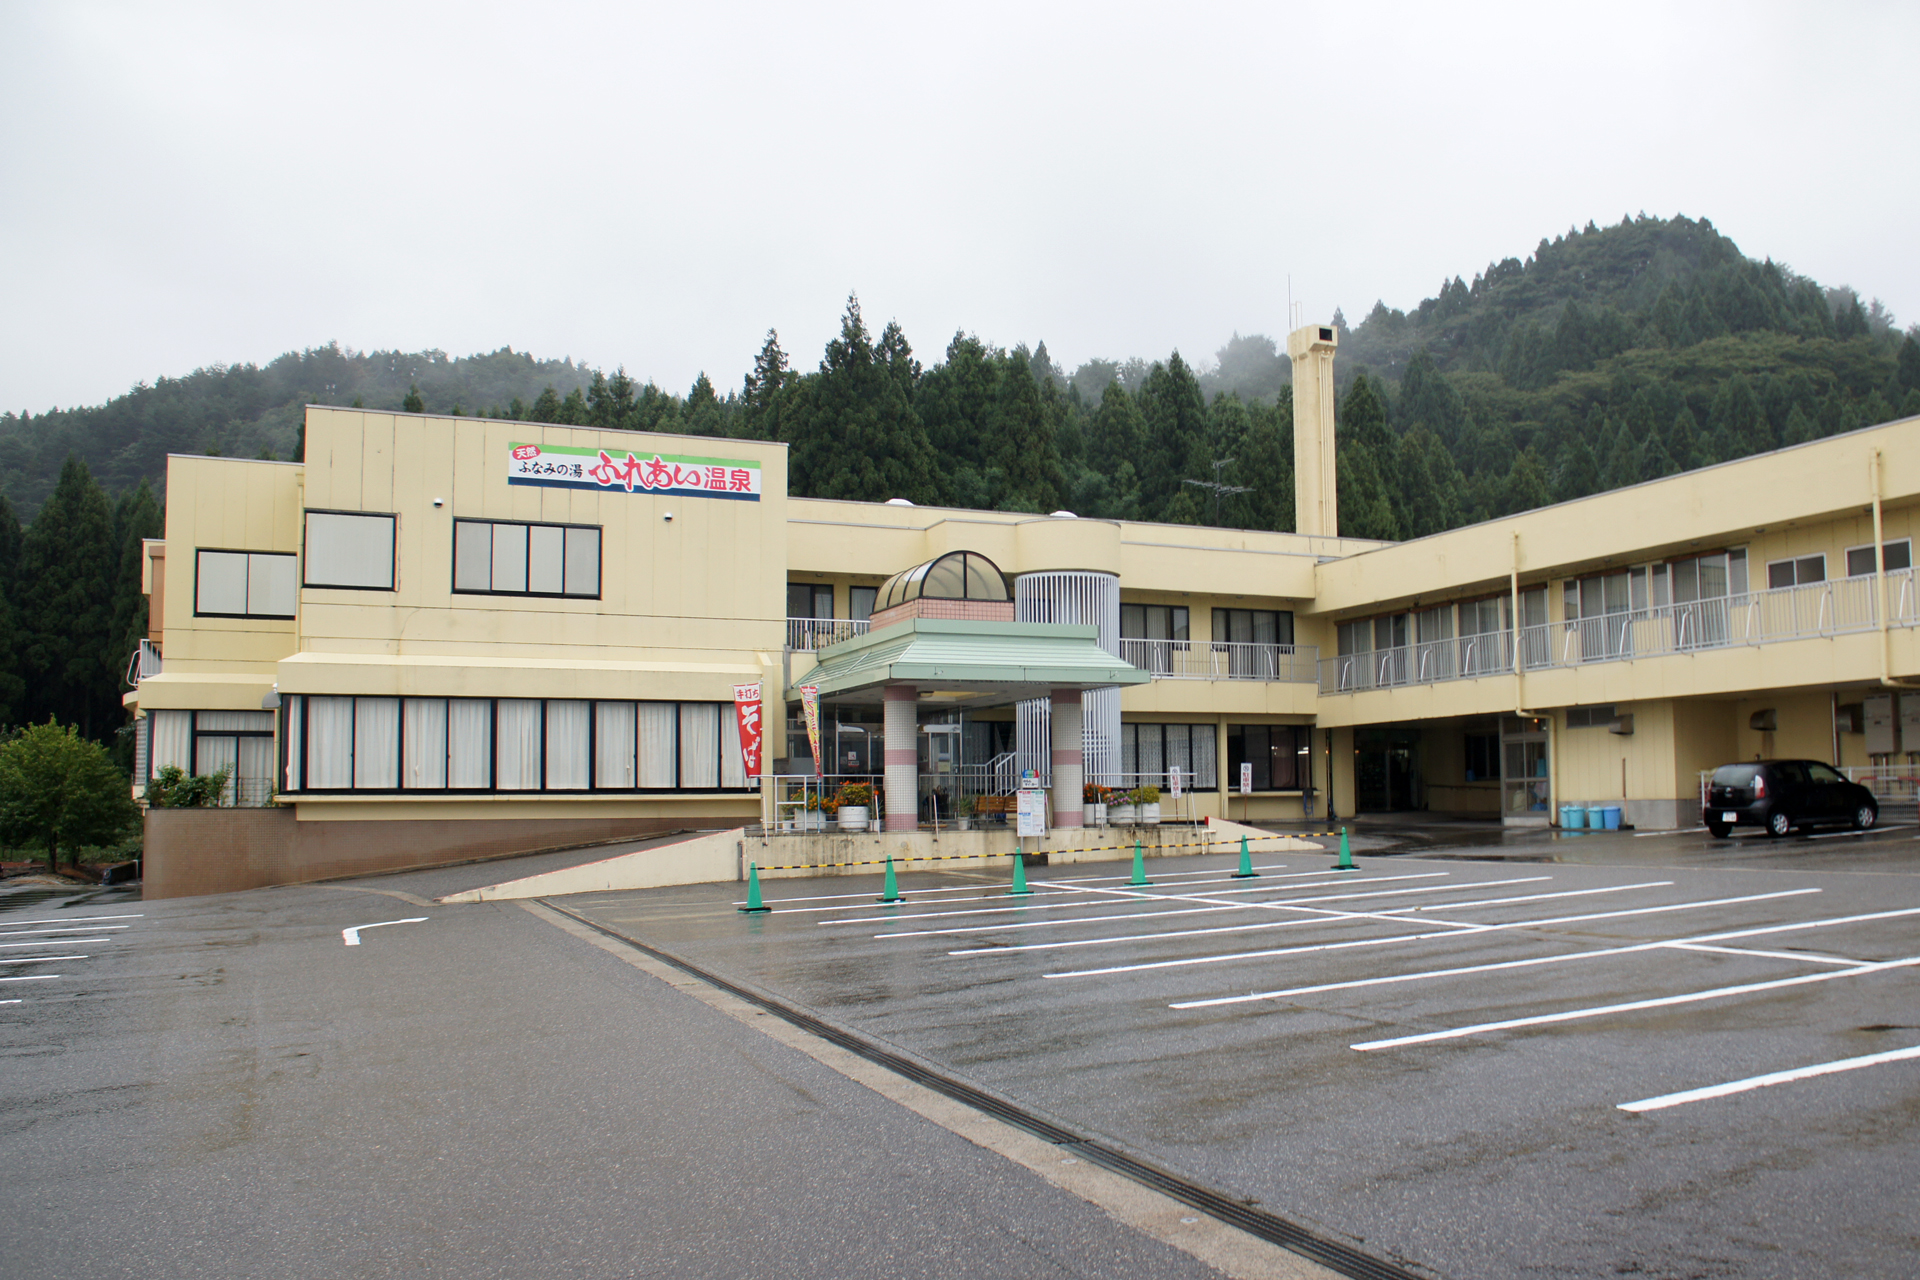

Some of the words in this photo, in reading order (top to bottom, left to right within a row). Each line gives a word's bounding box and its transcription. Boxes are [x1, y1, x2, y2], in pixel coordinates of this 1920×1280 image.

[516, 446, 538, 459] 天然
[519, 461, 584, 478] ふなみの湯
[588, 451, 752, 492] ふれあい温泉
[737, 688, 760, 700] 手打ち
[742, 704, 760, 769] そば
